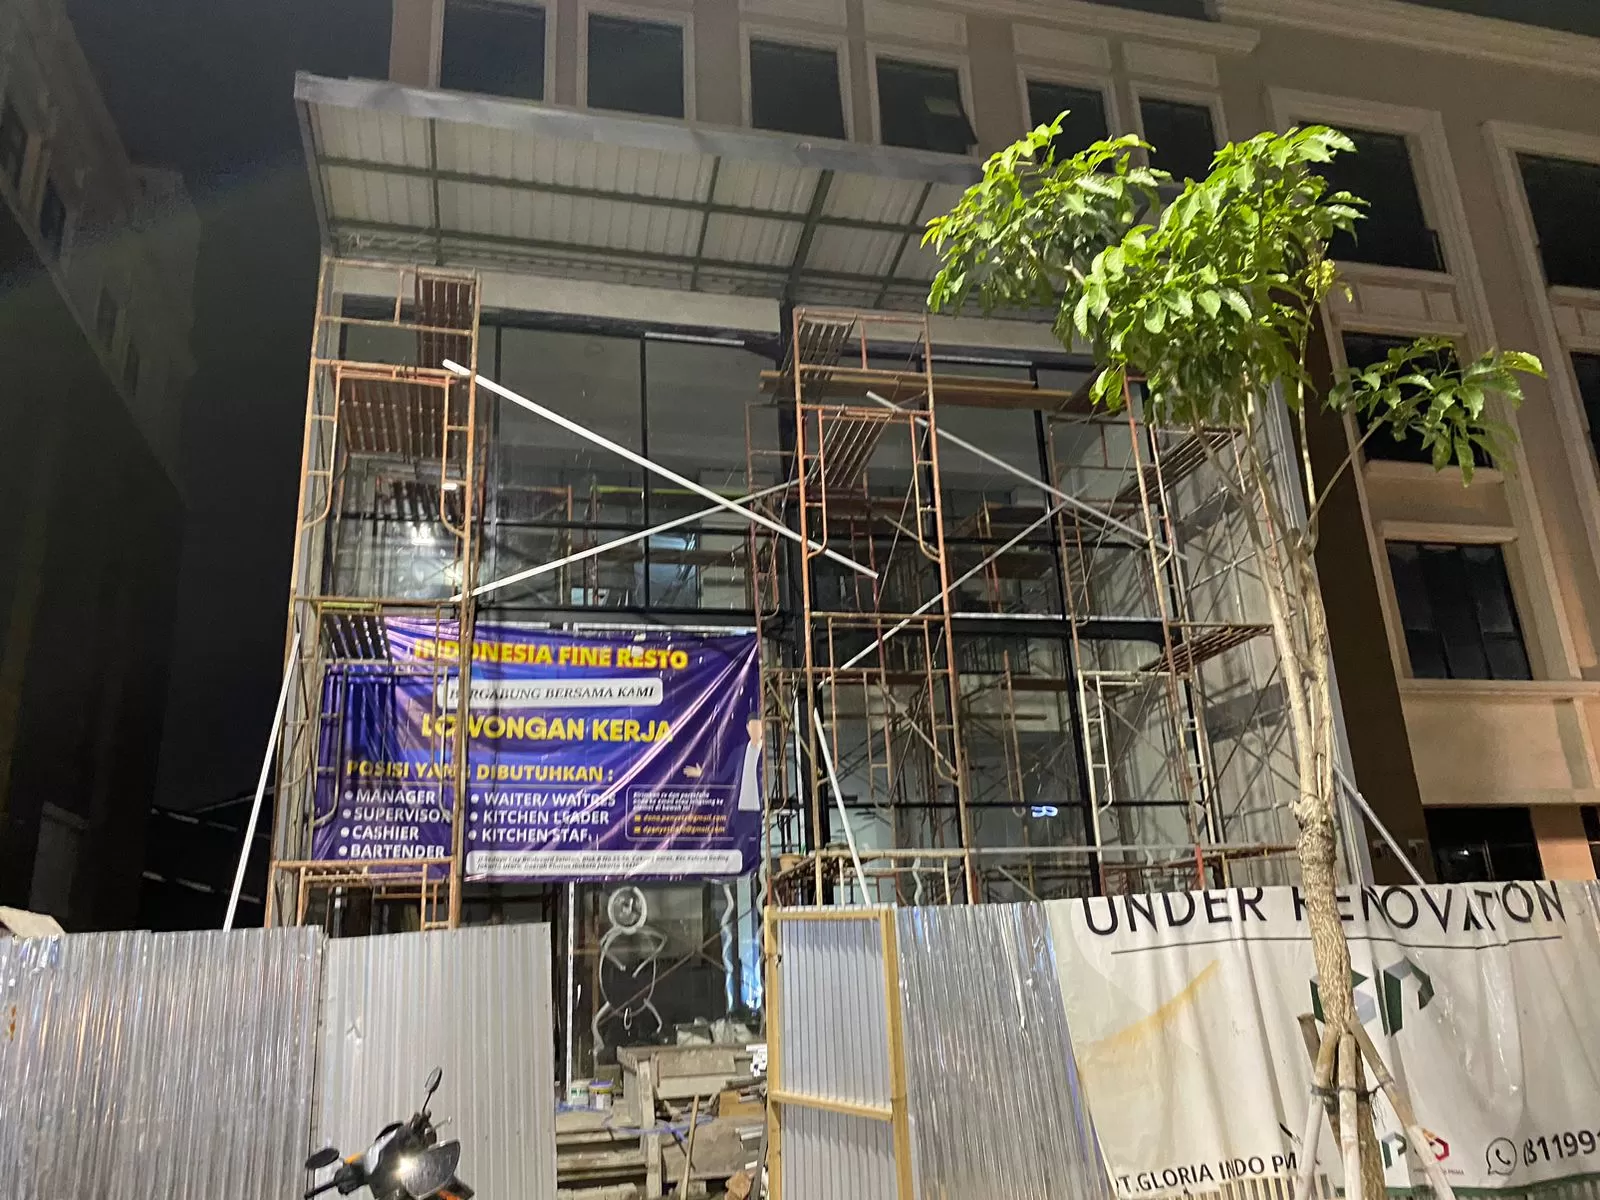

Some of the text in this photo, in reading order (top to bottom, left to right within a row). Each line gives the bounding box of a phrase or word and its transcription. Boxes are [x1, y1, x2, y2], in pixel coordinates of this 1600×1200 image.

[558, 645, 612, 667] FINE
[546, 687, 613, 698] BERSAMA
[618, 686, 655, 697] KAMI
[592, 719, 674, 742] KERJA
[347, 760, 409, 778] POSISI
[415, 762, 470, 779] YAN
[476, 763, 603, 782] DIBUTUHKAN
[356, 788, 436, 805] MANAGER
[483, 810, 609, 825] KITCHEN LEADER
[352, 825, 419, 841] CASHIER
[481, 828, 547, 843] KITCHEN
[350, 844, 445, 859] BARTENDER
[1083, 886, 1267, 936] UNDER
[1116, 1162, 1215, 1194] T.GLORIA
[1218, 1156, 1265, 1181] INDO
